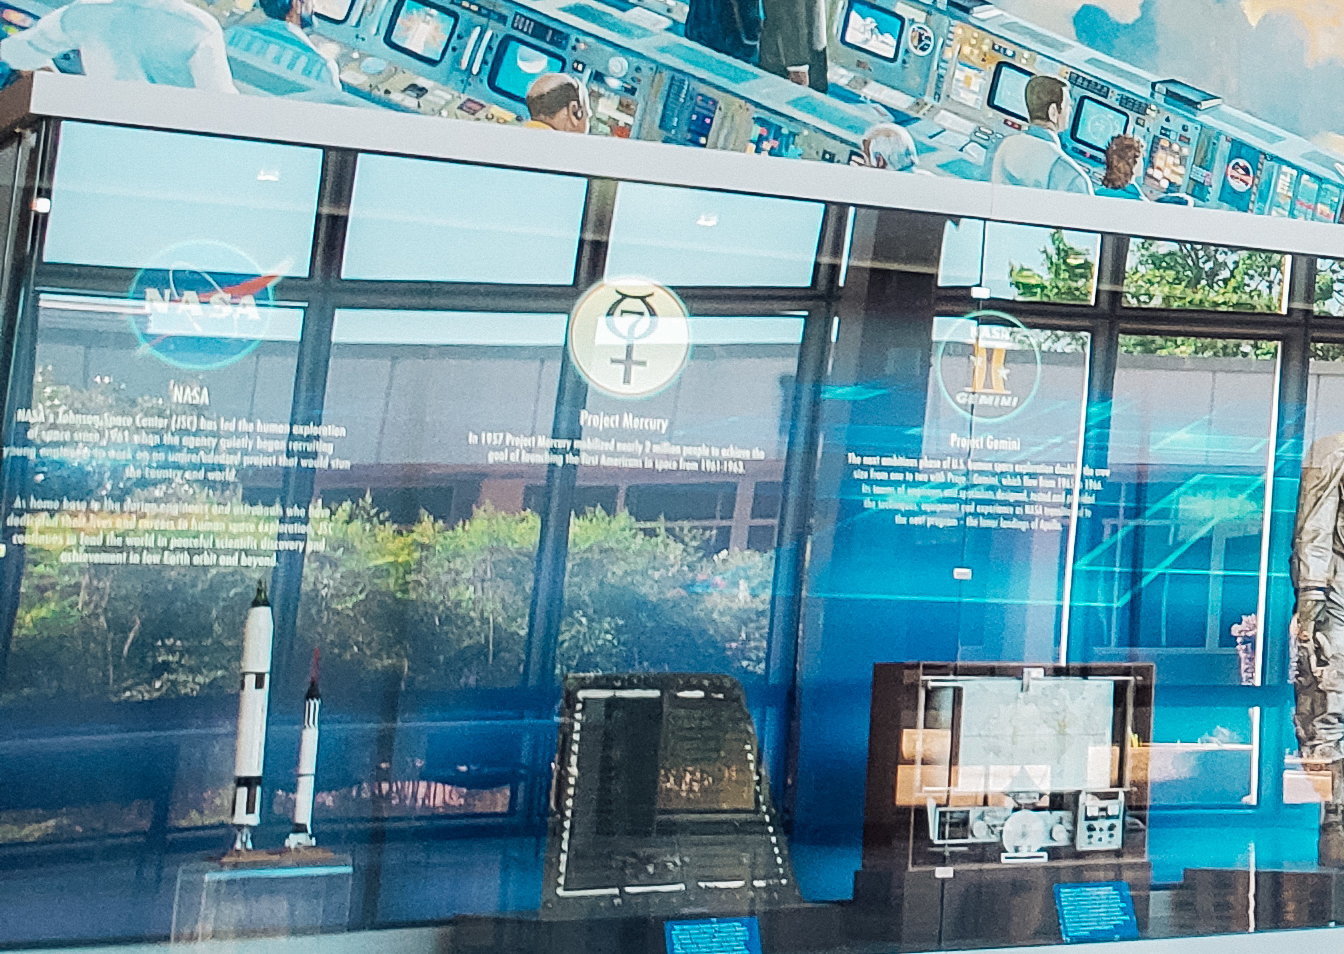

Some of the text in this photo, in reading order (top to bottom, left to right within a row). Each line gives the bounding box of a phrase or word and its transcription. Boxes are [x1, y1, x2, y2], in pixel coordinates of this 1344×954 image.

[144, 288, 261, 321] NASA
[173, 385, 209, 406] NASA
[135, 413, 169, 428] Center
[292, 421, 347, 438] exploration
[579, 409, 669, 435] Project Mercury
[256, 435, 288, 453] began
[289, 438, 334, 456] recruiting
[950, 432, 1021, 452] Project Gemini
[243, 454, 277, 469] project
[259, 537, 305, 554] discovery
[60, 547, 127, 564] achievement
[162, 550, 191, 567] Earth
[192, 550, 217, 567] orbit
[219, 551, 239, 567] and
